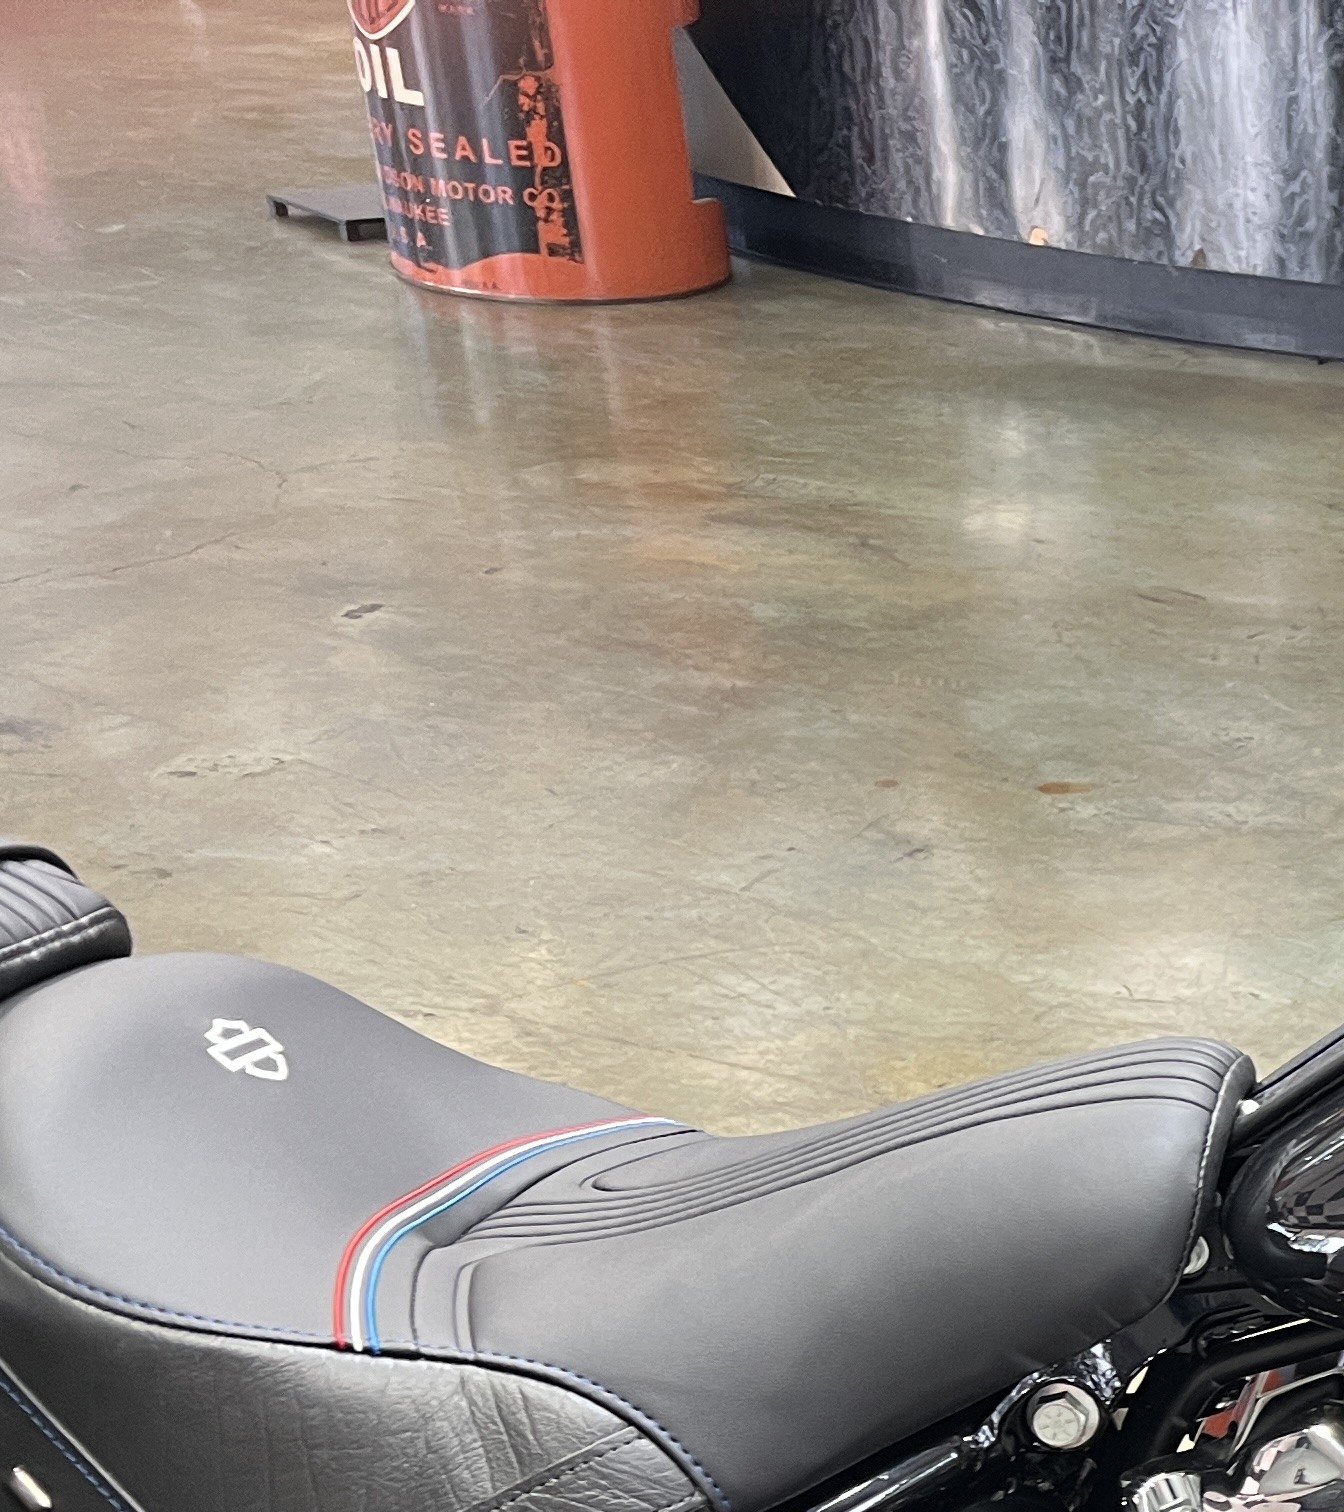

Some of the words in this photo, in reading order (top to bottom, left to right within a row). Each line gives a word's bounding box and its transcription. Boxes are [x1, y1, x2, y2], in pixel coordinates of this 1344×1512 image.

[353, 37, 425, 107] OIL
[407, 128, 562, 167] SEALED
[430, 177, 515, 206] MOTOR
